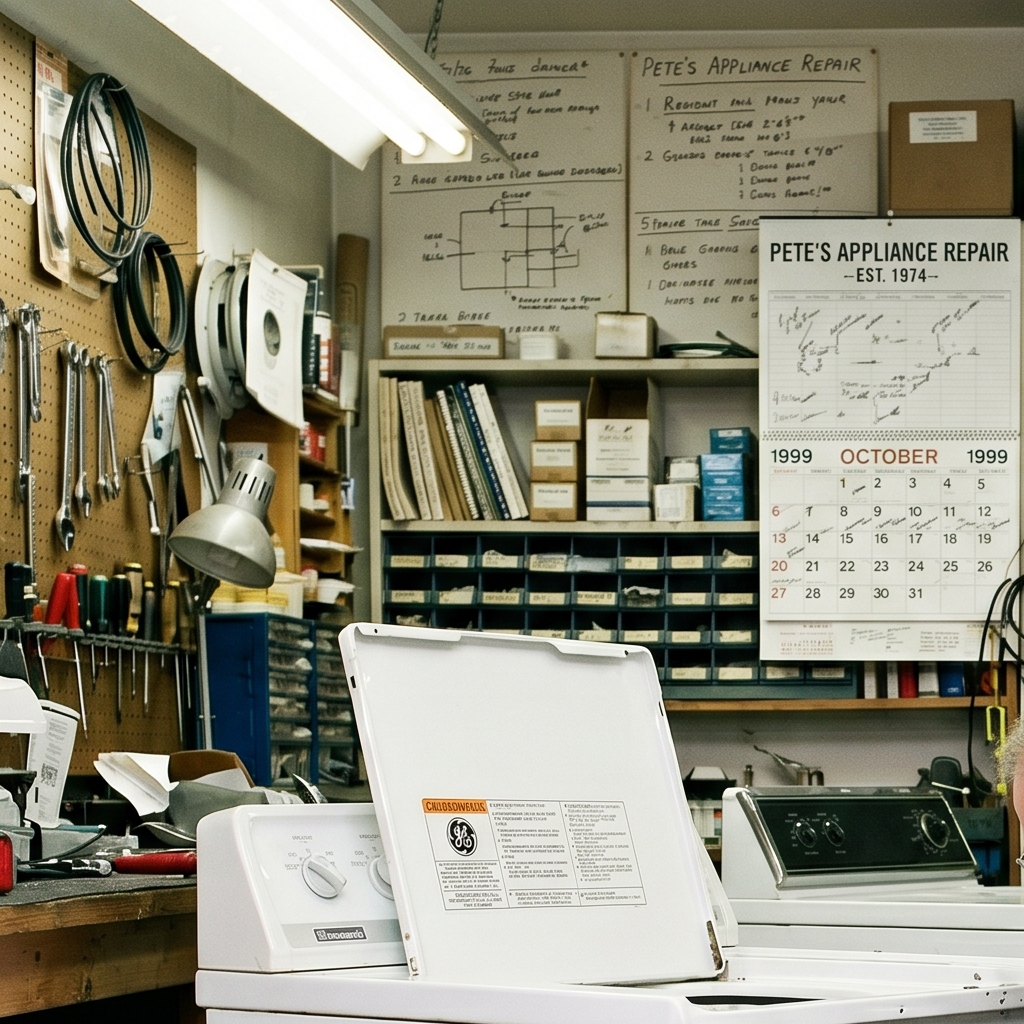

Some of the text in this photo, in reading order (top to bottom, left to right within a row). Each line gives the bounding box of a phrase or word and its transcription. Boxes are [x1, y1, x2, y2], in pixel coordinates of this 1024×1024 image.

[707, 56, 792, 76] APPLIANCE
[801, 53, 862, 73] REPAIR
[770, 242, 831, 262] PETE'S
[837, 242, 938, 262] APPLIANCE
[944, 242, 1009, 262] REPAIR
[856, 267, 927, 283] EST. 1974
[771, 448, 1008, 465] 1999 OCTOBER 1999
[839, 478, 986, 490] 1 2 3 4 5
[771, 506, 780, 517] 6
[840, 506, 848, 517] 8
[874, 506, 882, 517] 9
[908, 506, 922, 517] 10
[943, 506, 955, 517] 11
[978, 506, 992, 517] 12
[772, 533, 992, 544] 13 14 15 16 17 18 19
[771, 560, 993, 572] 20 21 22 23 24 25 26
[771, 588, 922, 599] 27 28 29 30 31
